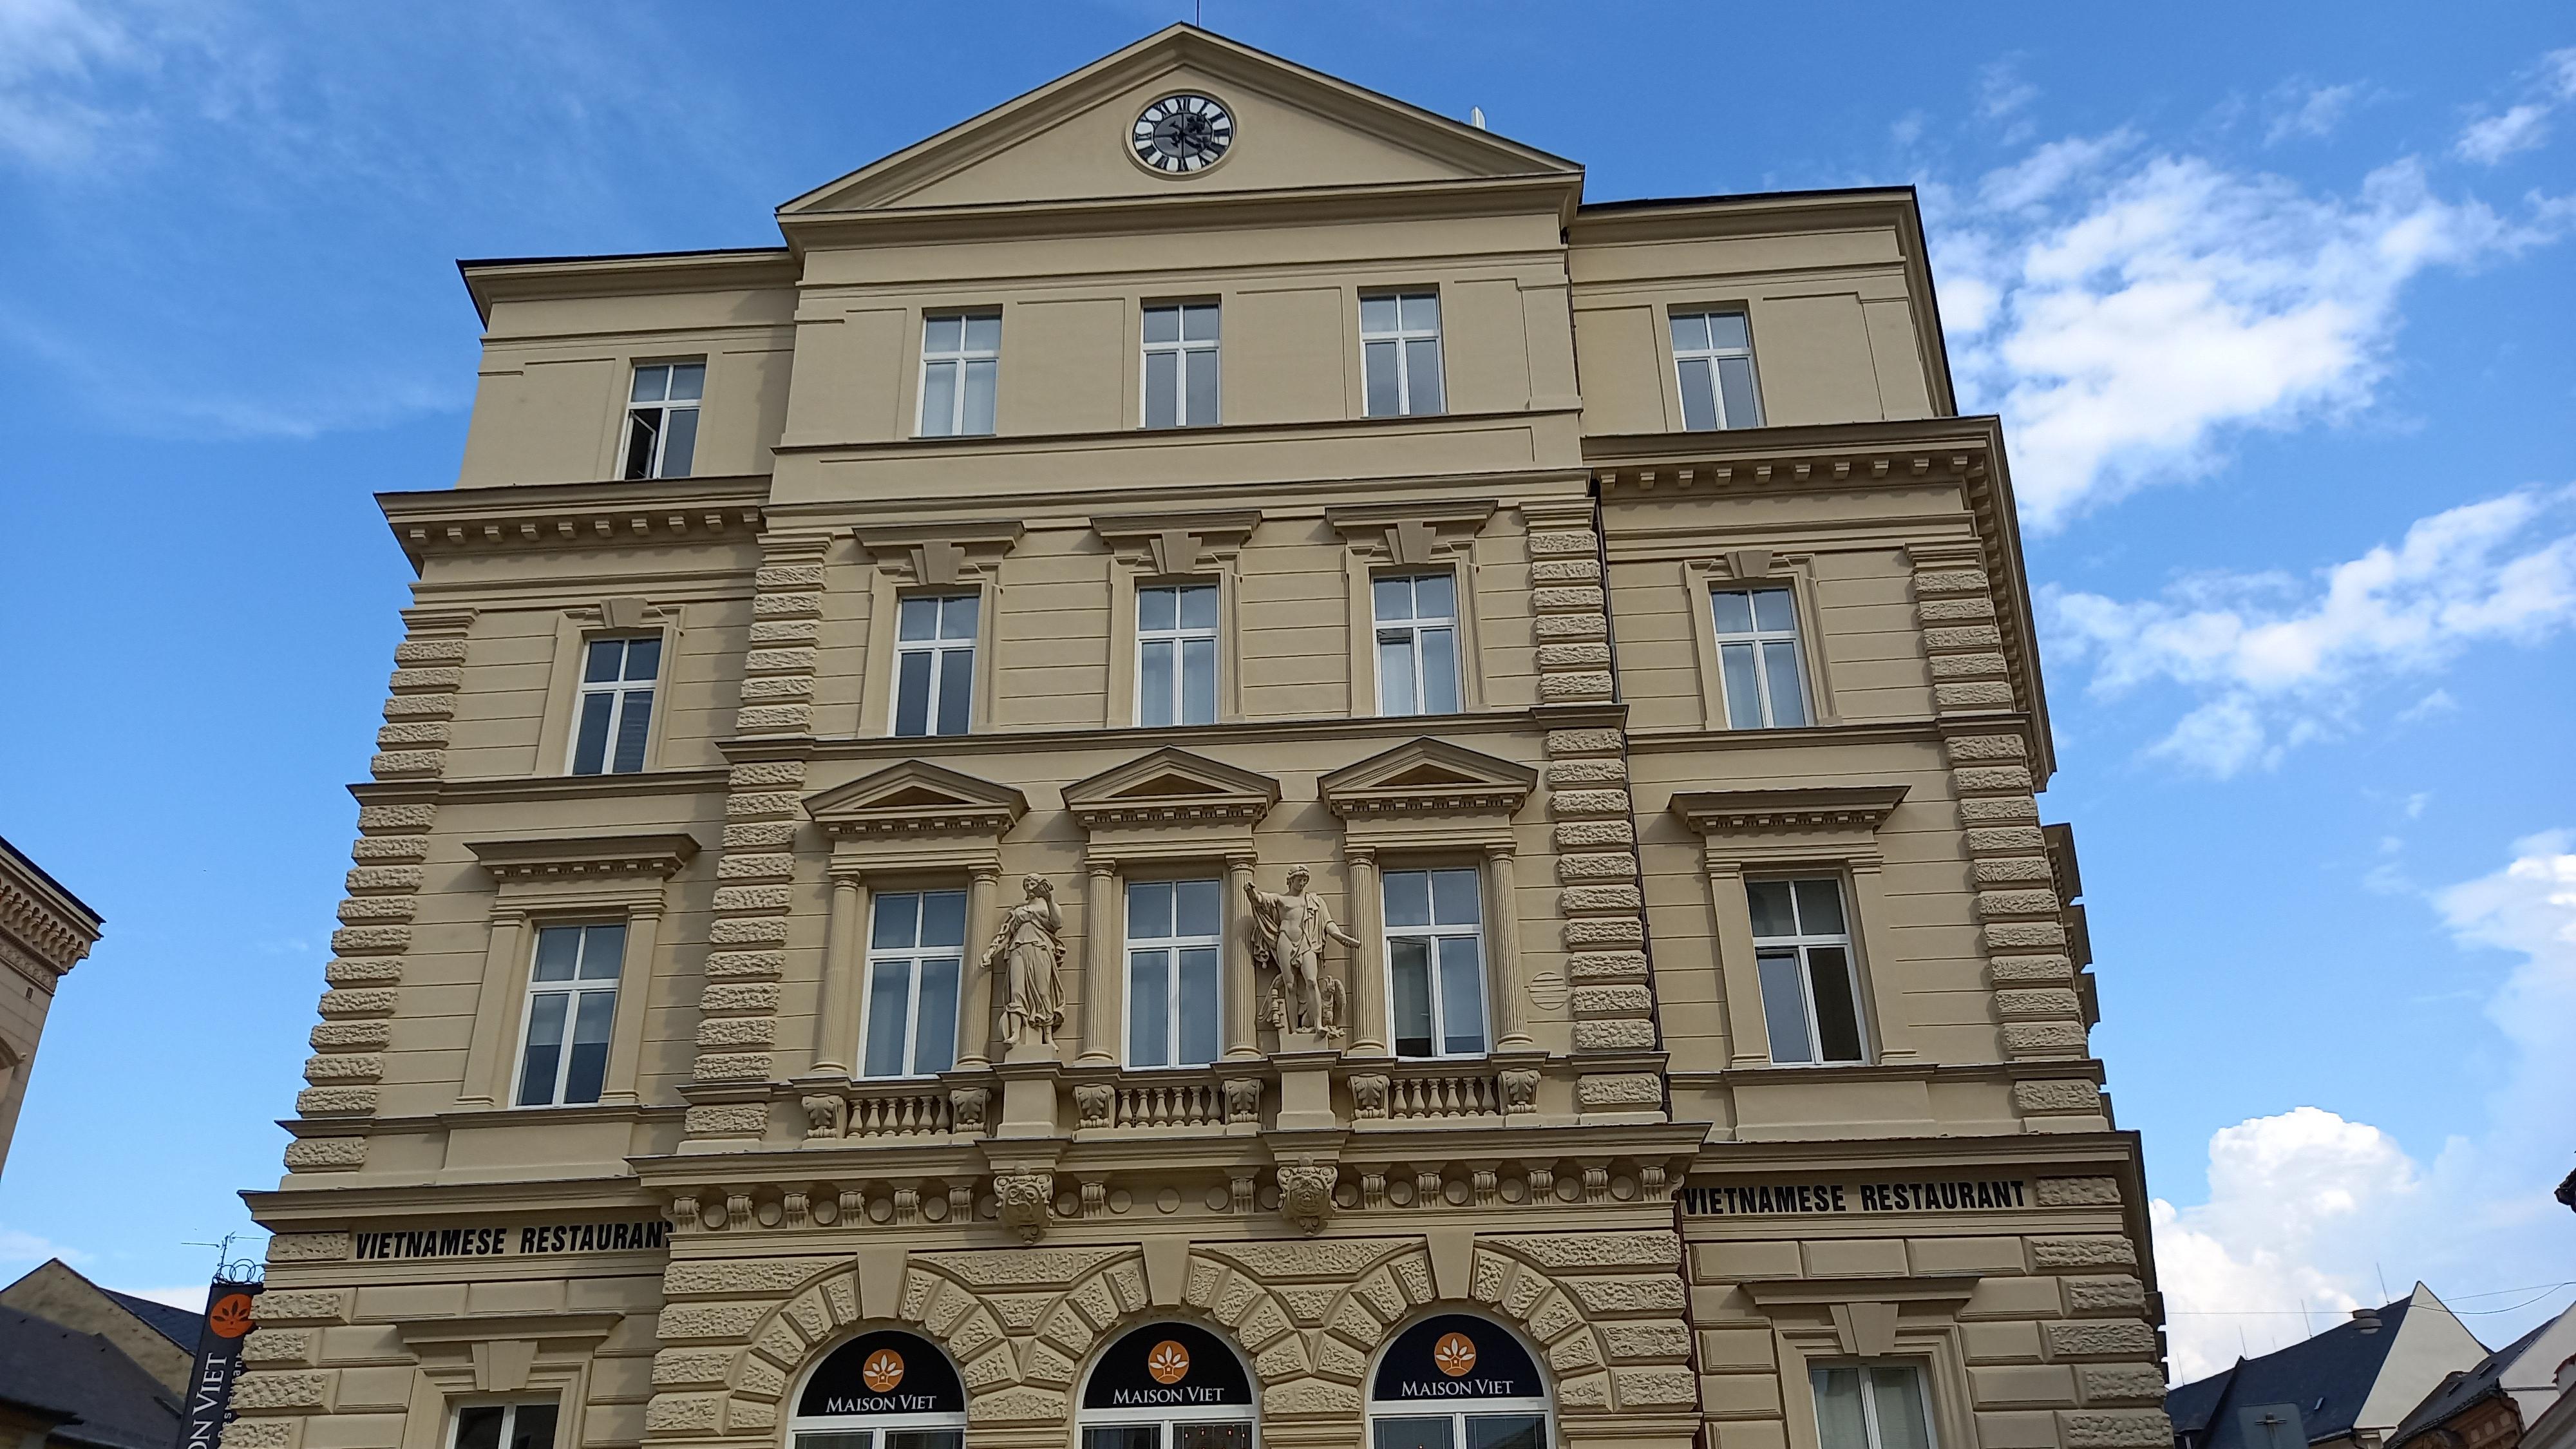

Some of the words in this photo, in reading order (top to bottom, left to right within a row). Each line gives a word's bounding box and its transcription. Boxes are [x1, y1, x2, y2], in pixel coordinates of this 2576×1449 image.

[1683, 1185, 1847, 1215] VIETNAMESE
[1862, 1180, 2025, 1211] RESTAURANT
[356, 1227, 507, 1259] VIETNAMESE
[192, 1352, 227, 1416] VIET
